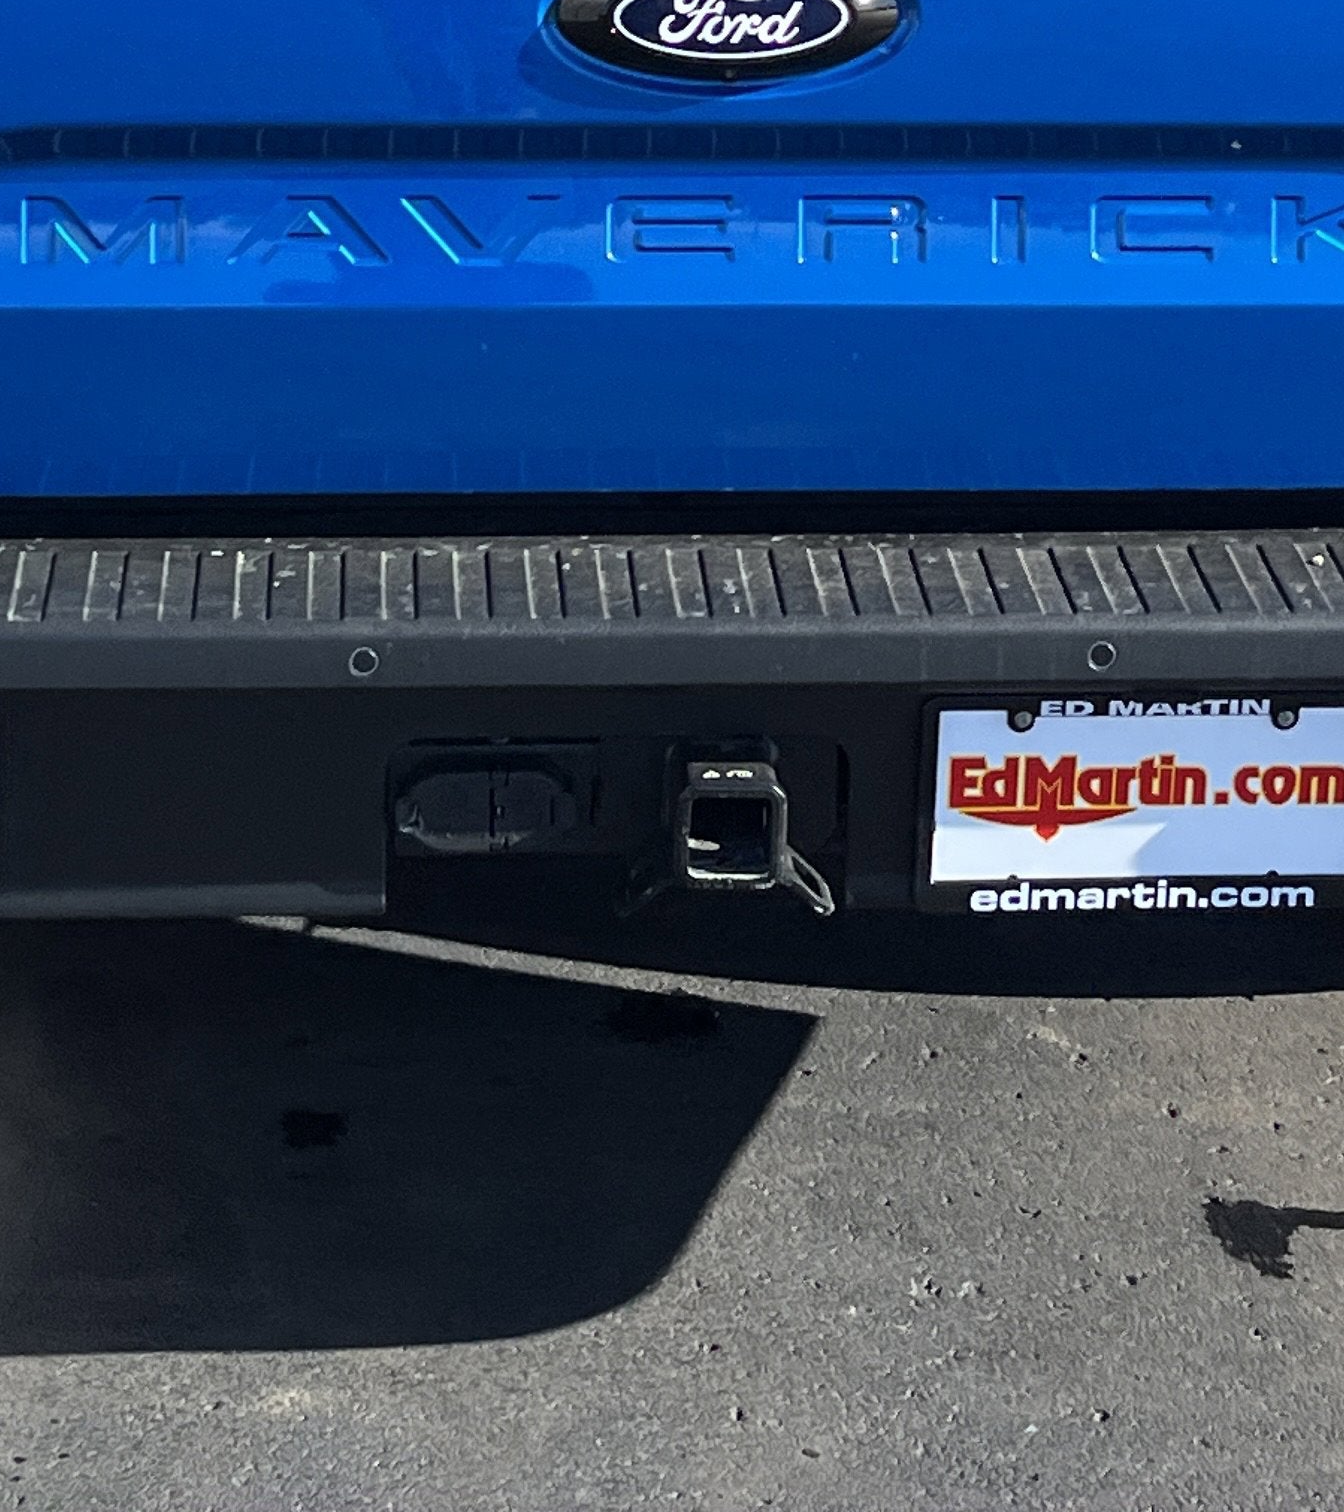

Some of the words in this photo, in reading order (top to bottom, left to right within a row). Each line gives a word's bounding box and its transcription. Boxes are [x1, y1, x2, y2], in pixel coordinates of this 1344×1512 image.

[1040, 699, 1095, 717] ED
[1108, 698, 1271, 717] MARTIN
[969, 879, 1315, 913] edmartin.com
